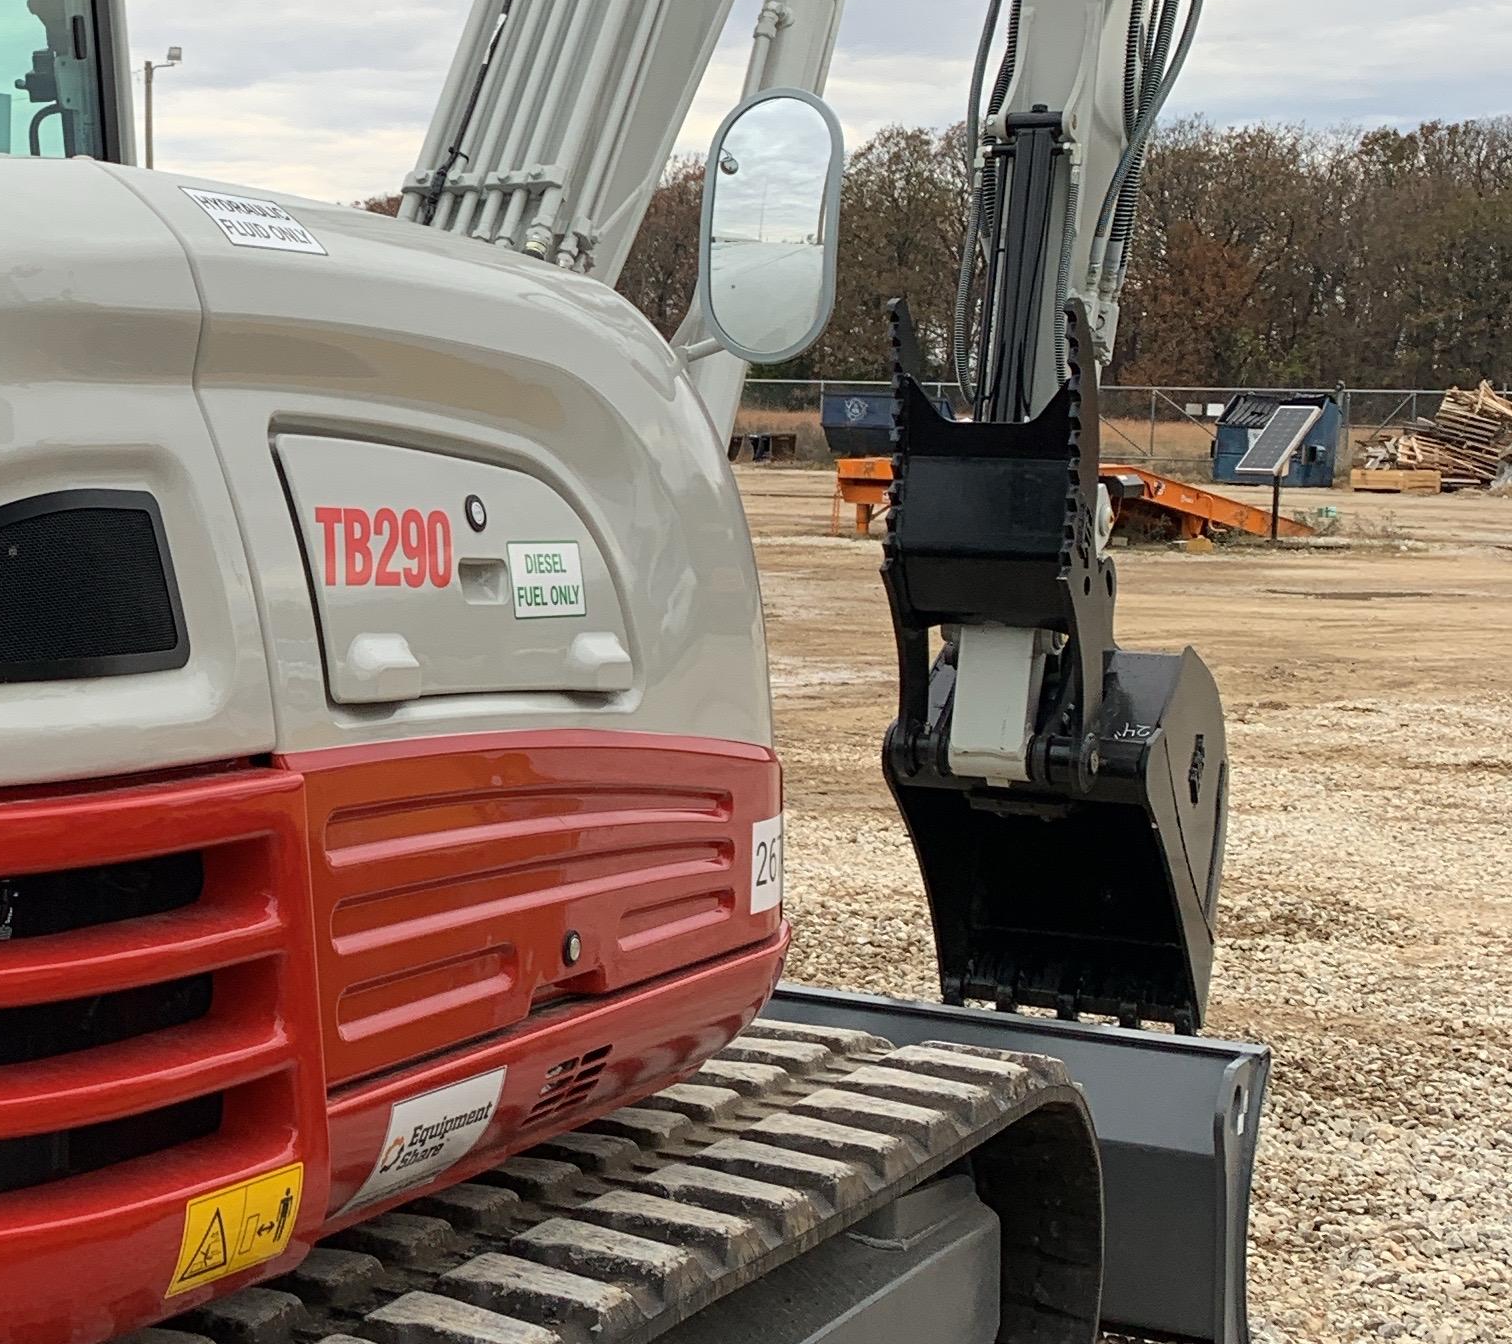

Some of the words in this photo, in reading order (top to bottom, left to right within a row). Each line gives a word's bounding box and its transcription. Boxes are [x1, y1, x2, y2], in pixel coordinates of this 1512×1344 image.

[192, 193, 291, 222] HYDRAULIC
[218, 218, 271, 240] FLUID
[269, 224, 313, 245] ONLY
[315, 506, 453, 589] TB290
[523, 552, 567, 575] DIESEL
[517, 585, 548, 607] FUEL
[550, 584, 580, 606] ONLY
[407, 1101, 493, 1149] Equipment
